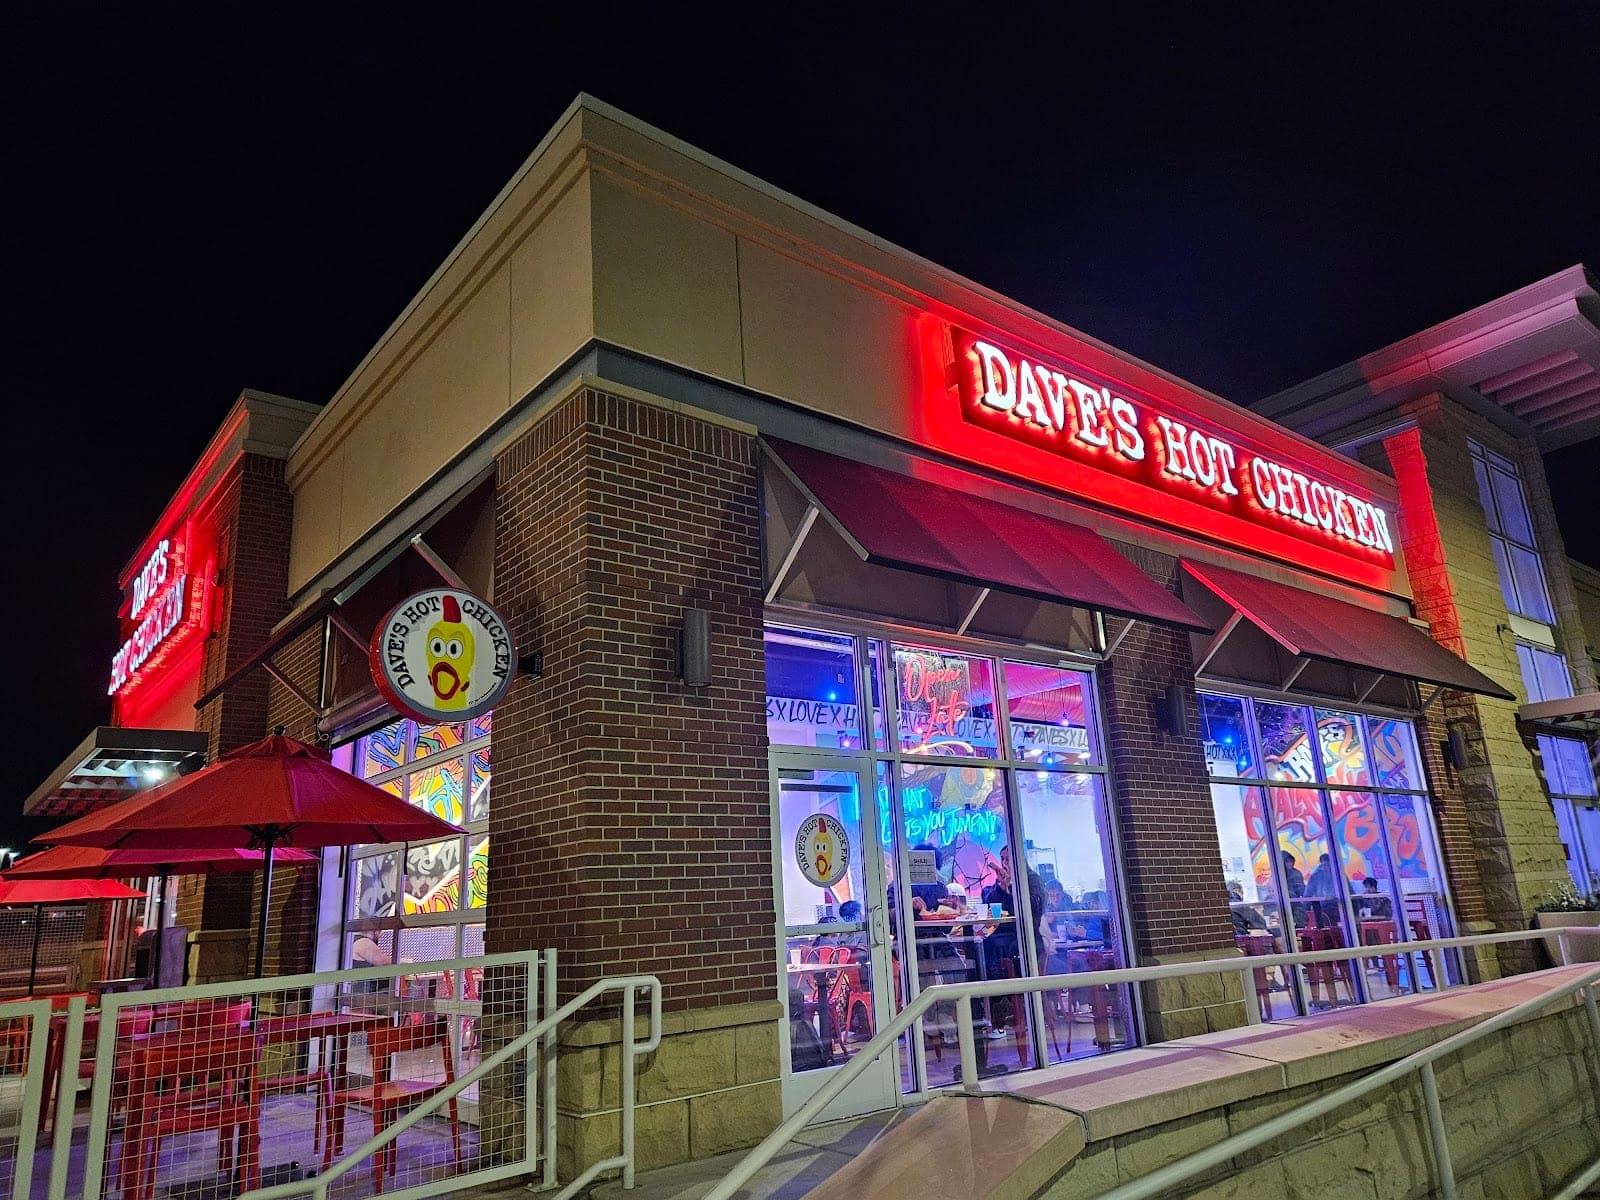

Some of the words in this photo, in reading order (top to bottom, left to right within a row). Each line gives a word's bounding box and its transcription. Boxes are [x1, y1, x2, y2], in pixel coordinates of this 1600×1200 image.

[974, 341, 1145, 461] DAVE'S
[1157, 415, 1239, 496] HOT
[1249, 456, 1393, 554] CHICKEN
[387, 622, 415, 690] DAVE'S
[402, 596, 441, 625] HOT
[461, 600, 511, 681] CHICKEN
[803, 818, 818, 836] HOT
[826, 819, 848, 866] CHICKEN
